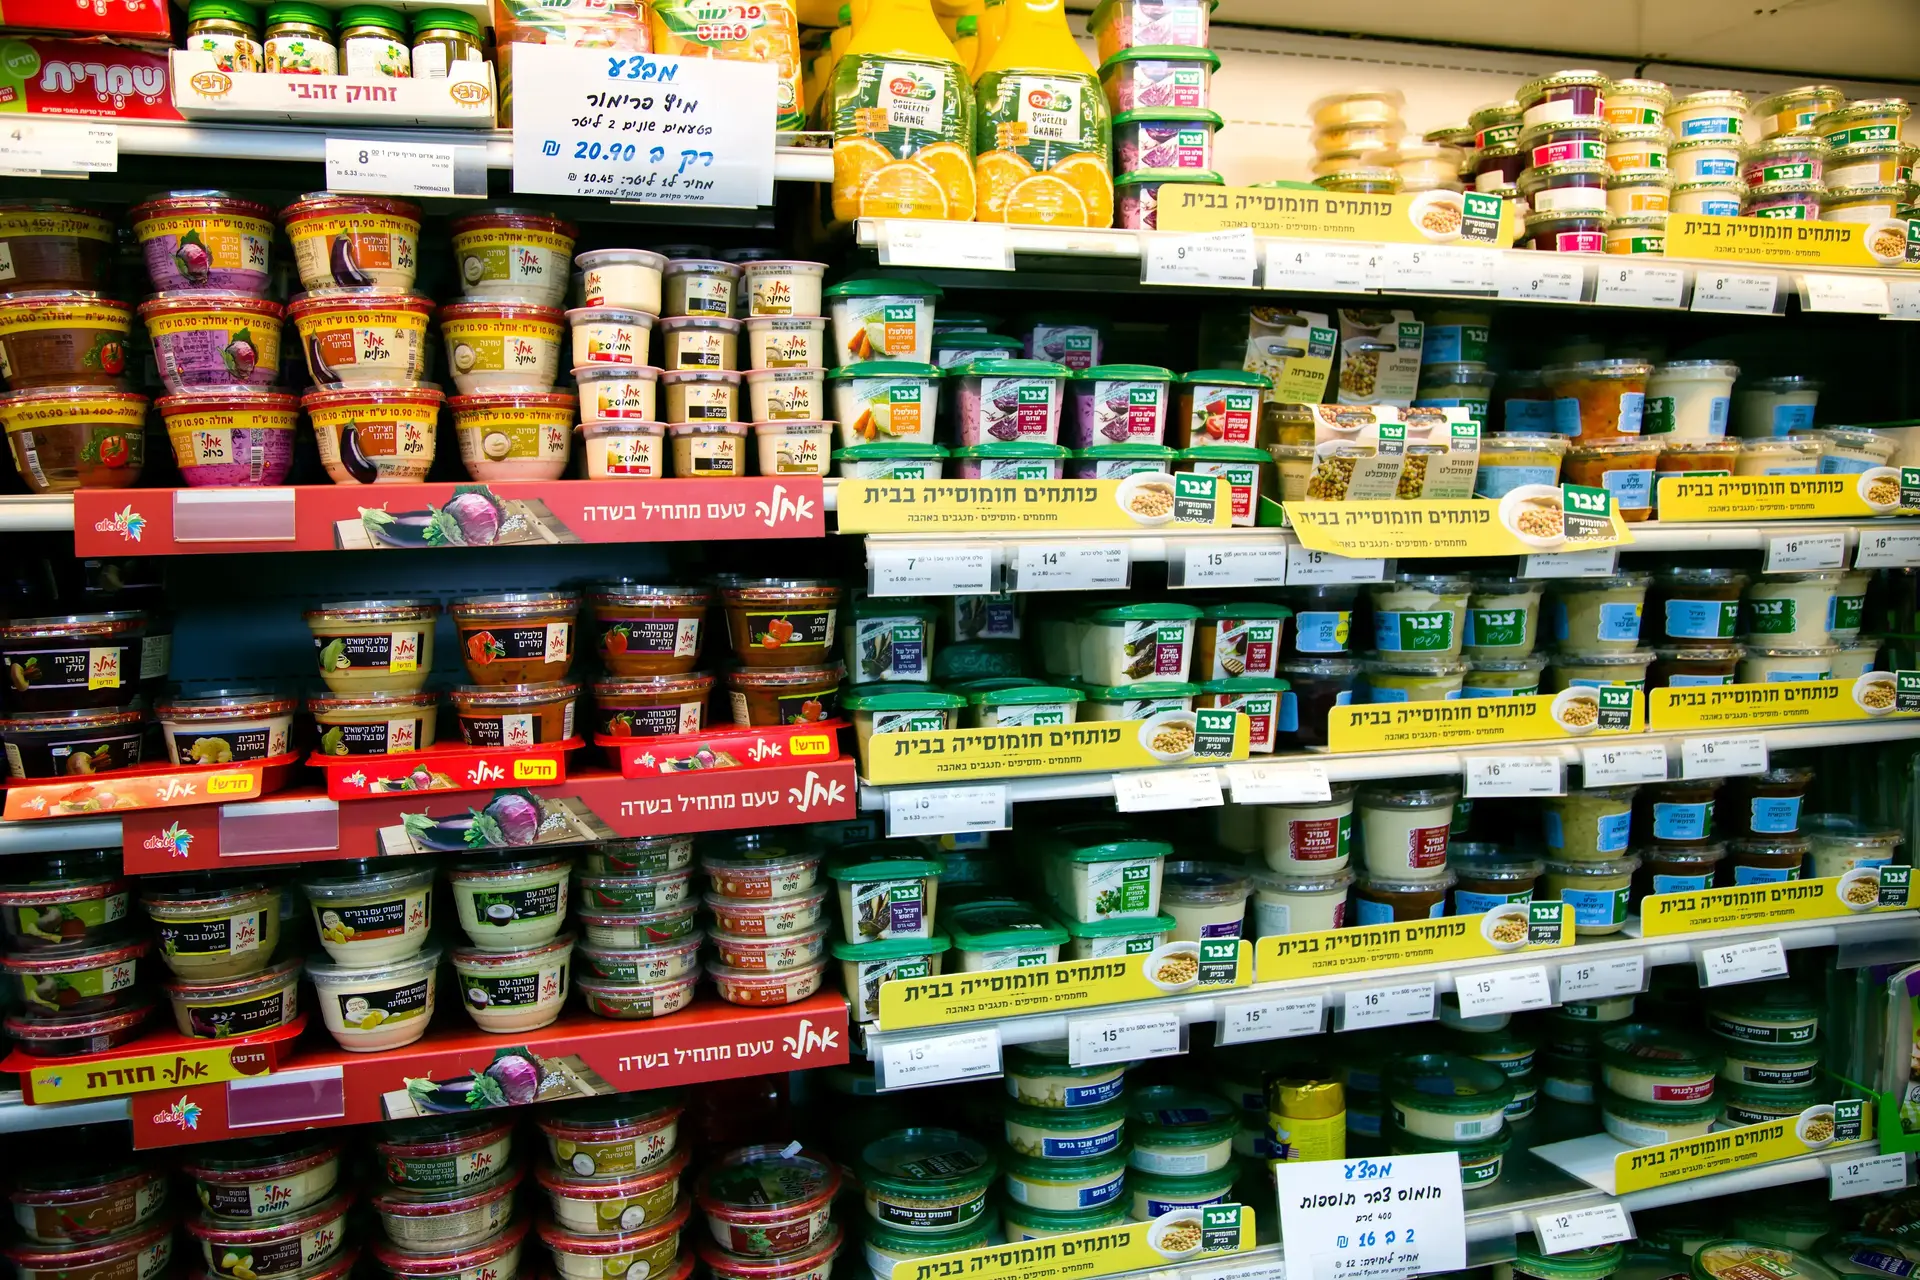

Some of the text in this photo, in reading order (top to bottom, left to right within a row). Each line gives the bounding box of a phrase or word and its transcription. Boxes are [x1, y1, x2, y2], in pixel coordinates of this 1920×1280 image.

[696, 4, 762, 21] פרימור
[696, 24, 749, 41] סחוט
[608, 55, 678, 83] מבצע
[40, 61, 166, 108] שמרית
[890, 81, 935, 100] Prigat
[289, 83, 397, 102] זחוק זהבי
[586, 92, 699, 114] מיץ פרימור
[572, 114, 713, 135] בטעמים שונים 2 ליטר
[893, 111, 924, 126] ORANGE
[11, 129, 22, 141] 4
[1180, 134, 1203, 145] צבר
[359, 150, 368, 164] 8
[542, 140, 714, 174] רק ב 20.90 ₪
[584, 173, 614, 183] 10.45
[621, 172, 657, 186] ליטר:
[1773, 165, 1805, 178] צבר
[683, 179, 714, 190] מחיר
[1182, 192, 1392, 217] פותחים חומוסייה בבית
[1468, 199, 1497, 216] צבר
[349, 219, 374, 228] 10.90
[380, 219, 400, 228] אחלה
[1684, 220, 1851, 242] פותחים חומוסייה בבית
[1295, 252, 1302, 265] 4
[1020, 388, 1048, 402] צבר
[1131, 391, 1155, 405] צבר
[368, 425, 394, 434] חצילים
[795, 453, 817, 462] טחינה
[864, 484, 1098, 505] פותחים חומוסייה בבית
[1179, 478, 1212, 496] צבר
[1676, 480, 1844, 498] פותחים חומוסייה בבית
[583, 485, 815, 527] אחלה טעם מתחיל בשדה
[1567, 488, 1606, 511] צבר
[907, 558, 915, 570] 7
[1042, 553, 1057, 565] 14
[645, 623, 674, 632] מטבוחה
[1406, 614, 1444, 630] צבר
[514, 630, 543, 640] פלפלים
[55, 655, 85, 665] קוביות
[65, 663, 85, 672] סלק
[1603, 691, 1629, 705] צבר
[1200, 713, 1232, 730] צבר
[1350, 702, 1537, 726] פותחים חומוסייה בבית
[238, 734, 265, 743] כרובית
[895, 728, 1122, 757] פותחים חומוסייה בבית
[236, 743, 265, 752] בטחינה
[747, 738, 825, 763] אחלה חדש!
[1702, 743, 1714, 754] 16
[518, 763, 552, 776] חדש!
[1487, 765, 1500, 776] 16
[212, 777, 248, 790] חדש!
[620, 770, 847, 817] אחלה טעם מתחיל בשדה
[892, 887, 918, 900] צבר
[1659, 884, 1824, 915] פותחים חומוסייה בבית
[1531, 905, 1560, 920] צבר
[1277, 922, 1466, 957] פותחים חומוסייה בבית
[1204, 942, 1235, 959] צבר
[514, 977, 534, 985] טחינה
[904, 962, 1126, 1003] פותחים חומוסייה בבית
[1102, 1030, 1117, 1042] 15
[1789, 1028, 1810, 1040] צבר
[618, 1019, 839, 1071] אחלה טעם מתחיל בשדה
[231, 1052, 265, 1064] חדש!
[87, 1056, 208, 1090] אחלה חזרת
[1631, 1124, 1784, 1171] פותחים חומוסייה בבית
[1344, 1159, 1392, 1179] מבצע
[1300, 1186, 1442, 1209] חומוס צבר תוספות
[1355, 1212, 1392, 1223] 400 גרם
[1555, 1217, 1569, 1229] 12
[1337, 1229, 1415, 1248] 2 ב 16 ₪
[917, 1232, 1131, 1280] פותחים חומוסייה בבית
[1360, 1252, 1394, 1268] ליחידה:
[1398, 1253, 1420, 1262] מחיר
